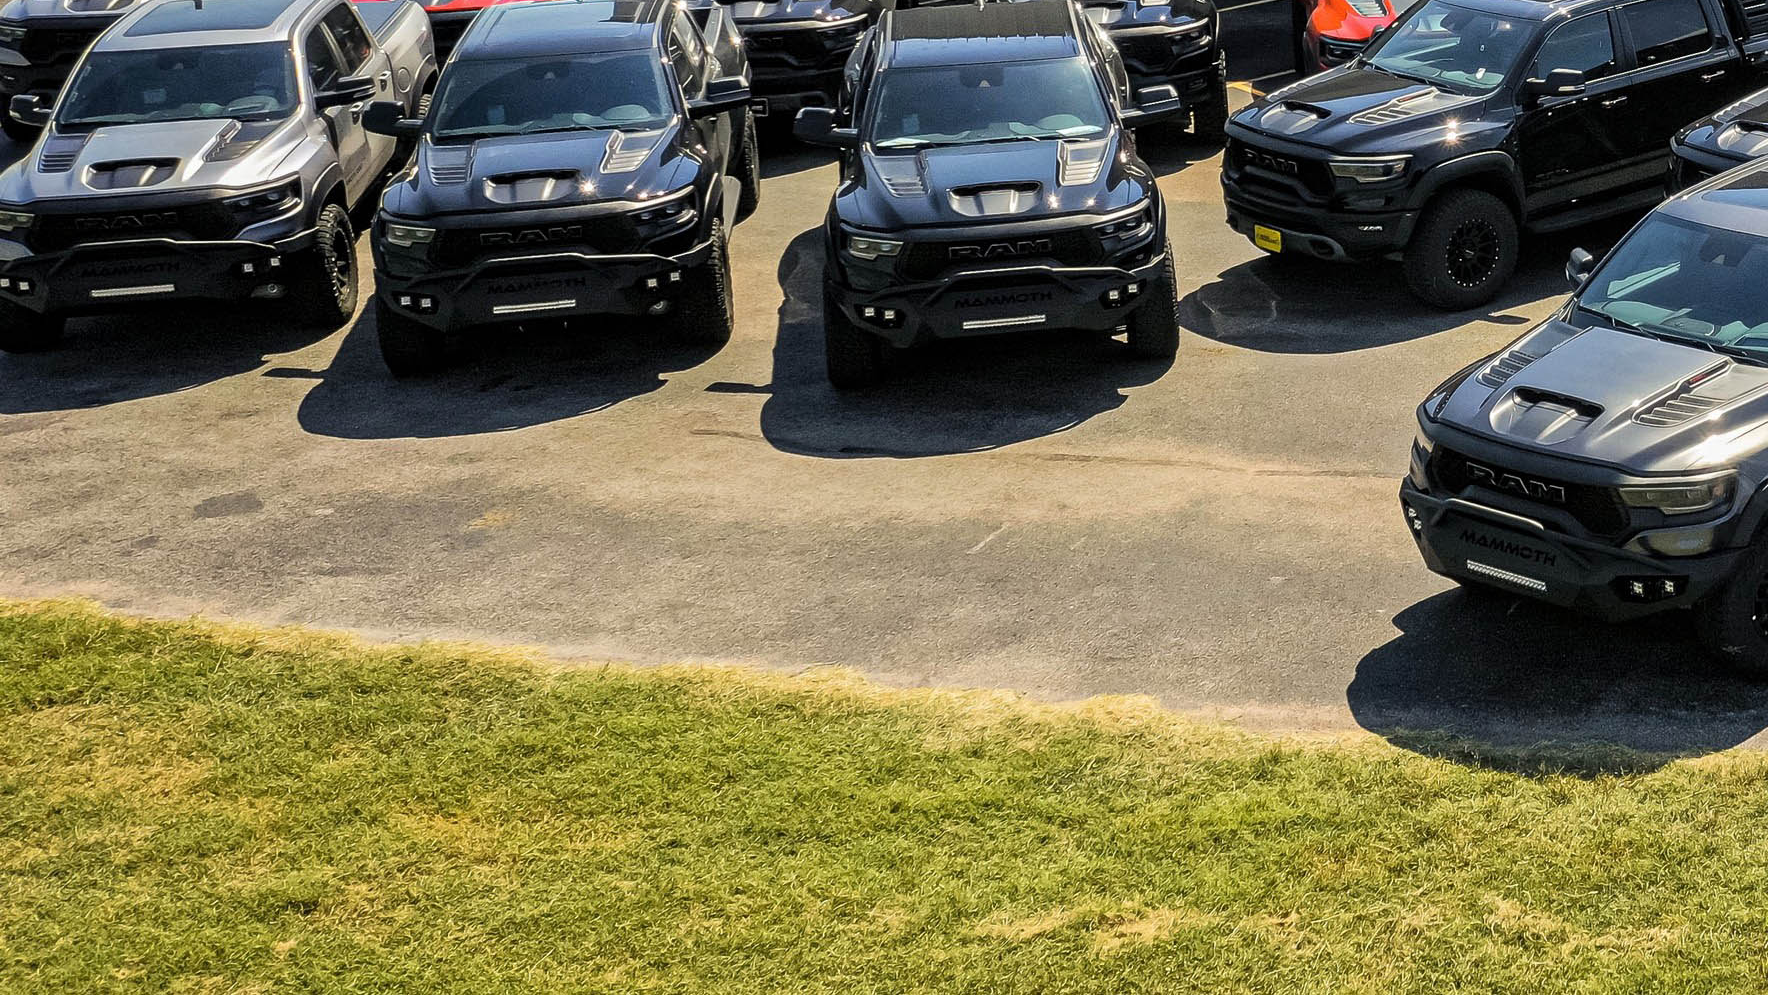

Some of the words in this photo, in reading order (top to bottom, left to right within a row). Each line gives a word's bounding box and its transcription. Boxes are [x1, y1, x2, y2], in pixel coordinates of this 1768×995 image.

[1242, 148, 1298, 174] RAM
[73, 211, 178, 231] RAM
[479, 225, 583, 246] RAM
[948, 238, 1053, 261] RAM
[487, 276, 586, 294] MAMMOTH
[954, 291, 1053, 309] MAMMOTH
[1465, 461, 1567, 503] RAM
[1459, 530, 1557, 567] MAMMOTH
